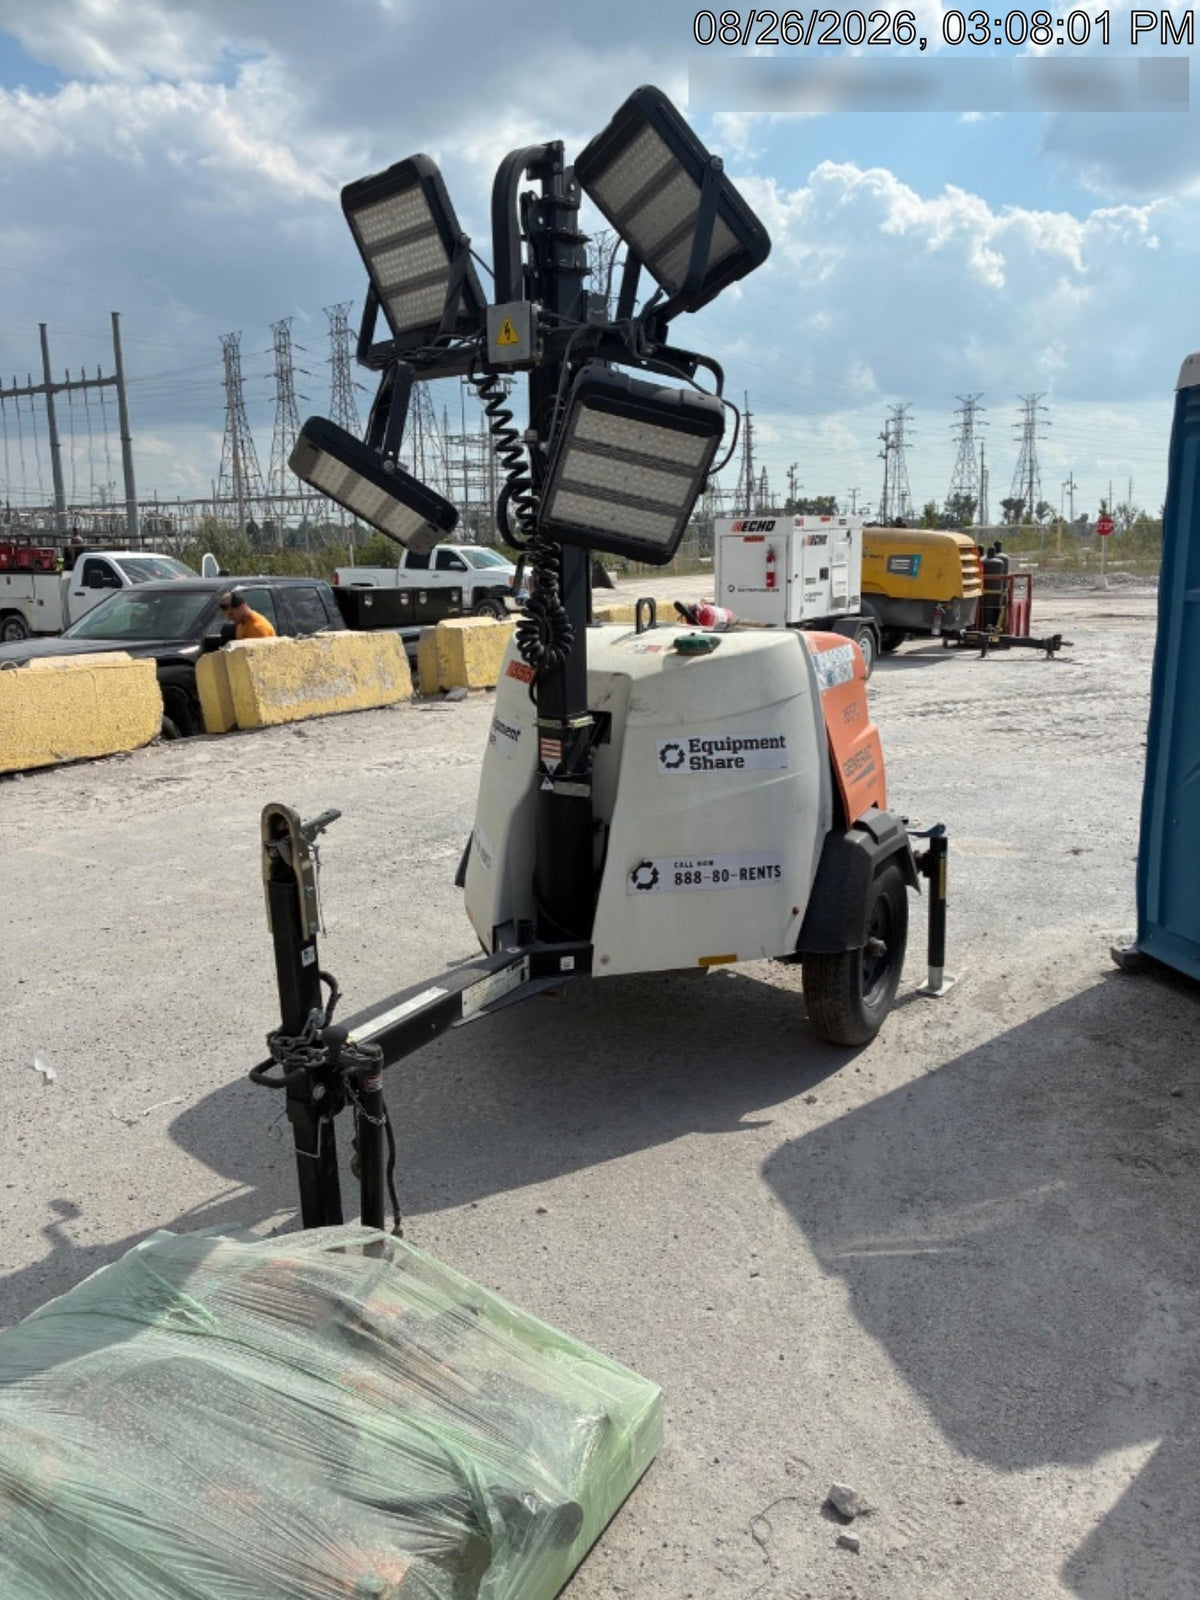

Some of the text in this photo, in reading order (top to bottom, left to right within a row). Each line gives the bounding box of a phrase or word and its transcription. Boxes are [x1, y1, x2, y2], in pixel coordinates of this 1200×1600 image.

[741, 520, 776, 533] ECHO
[688, 735, 786, 755] Equipment
[689, 755, 745, 771] Share
[673, 860, 693, 869] CALL
[674, 865, 781, 885] 888-80-RENTS
